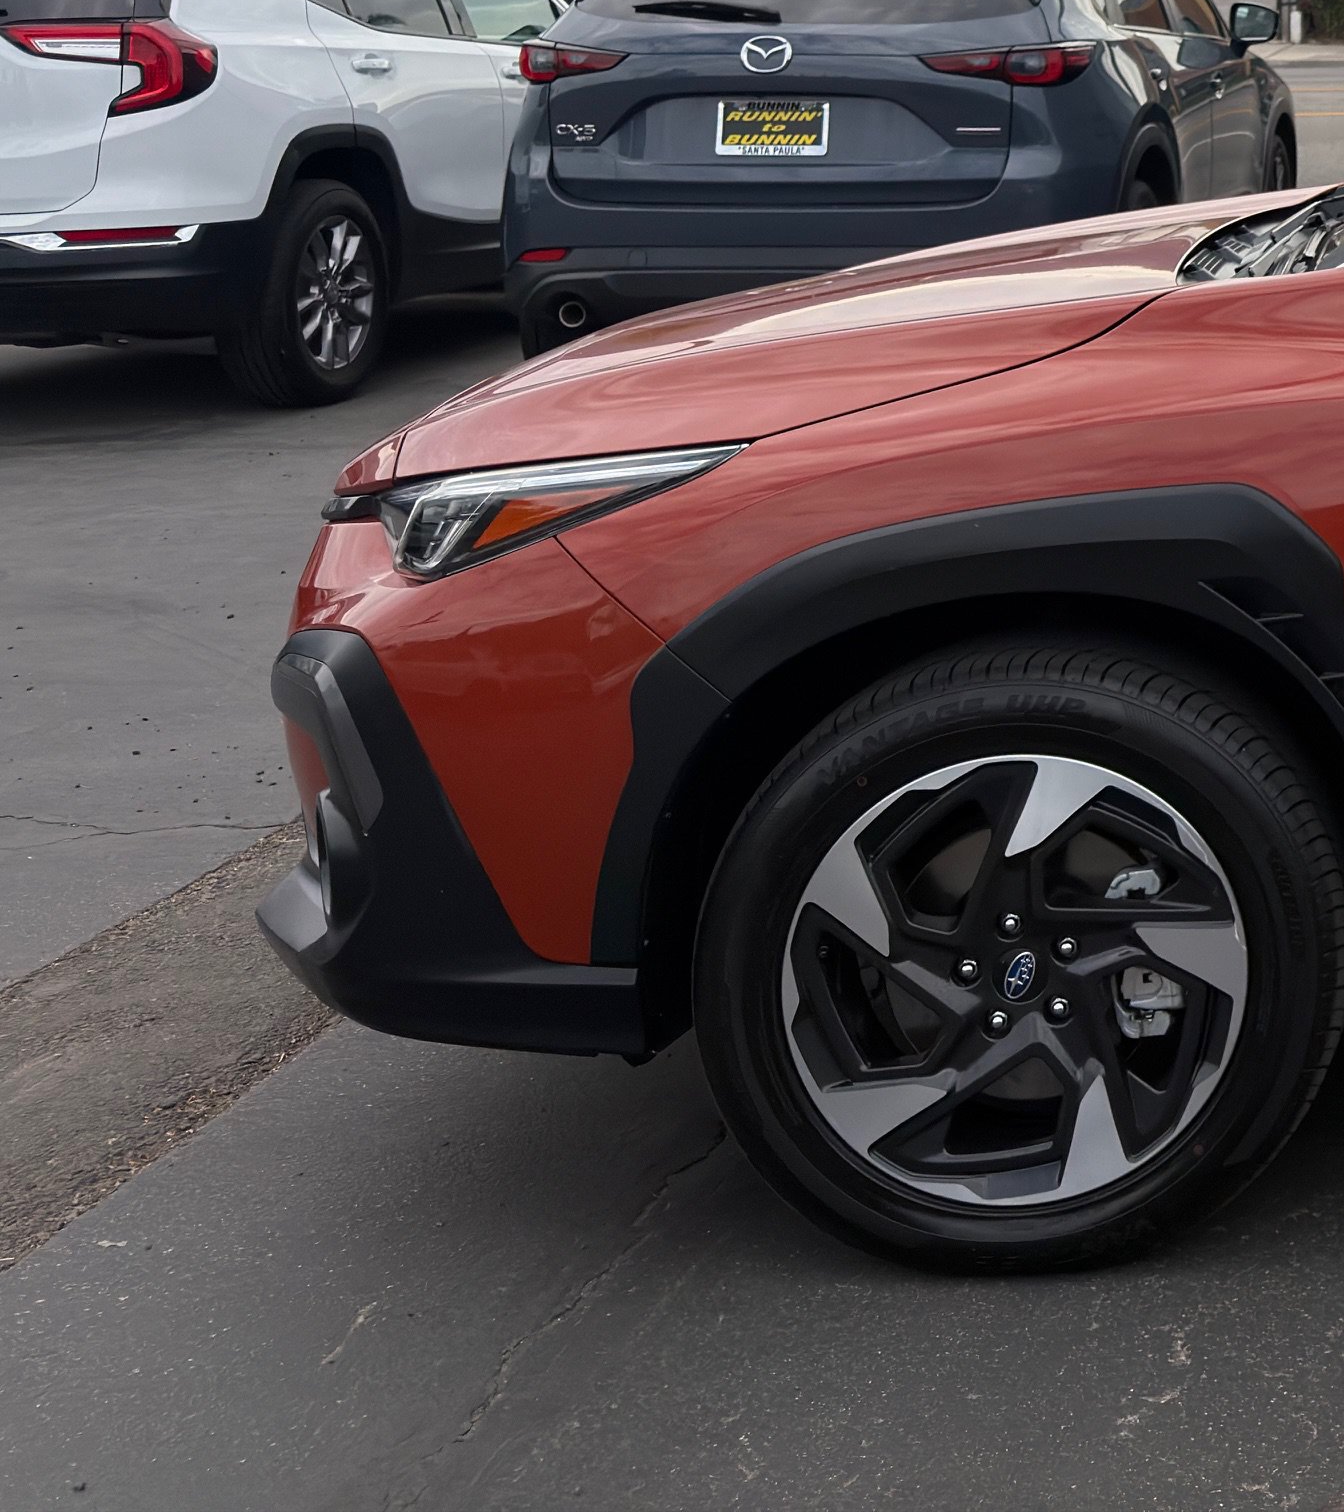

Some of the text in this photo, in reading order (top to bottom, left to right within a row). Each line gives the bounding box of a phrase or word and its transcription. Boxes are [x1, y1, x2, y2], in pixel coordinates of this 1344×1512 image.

[726, 110, 822, 122] RUNNIN'
[555, 123, 596, 136] CX-5
[762, 122, 786, 132] to
[724, 134, 817, 145] BUNNIN
[742, 146, 801, 155] SANTA PAULA
